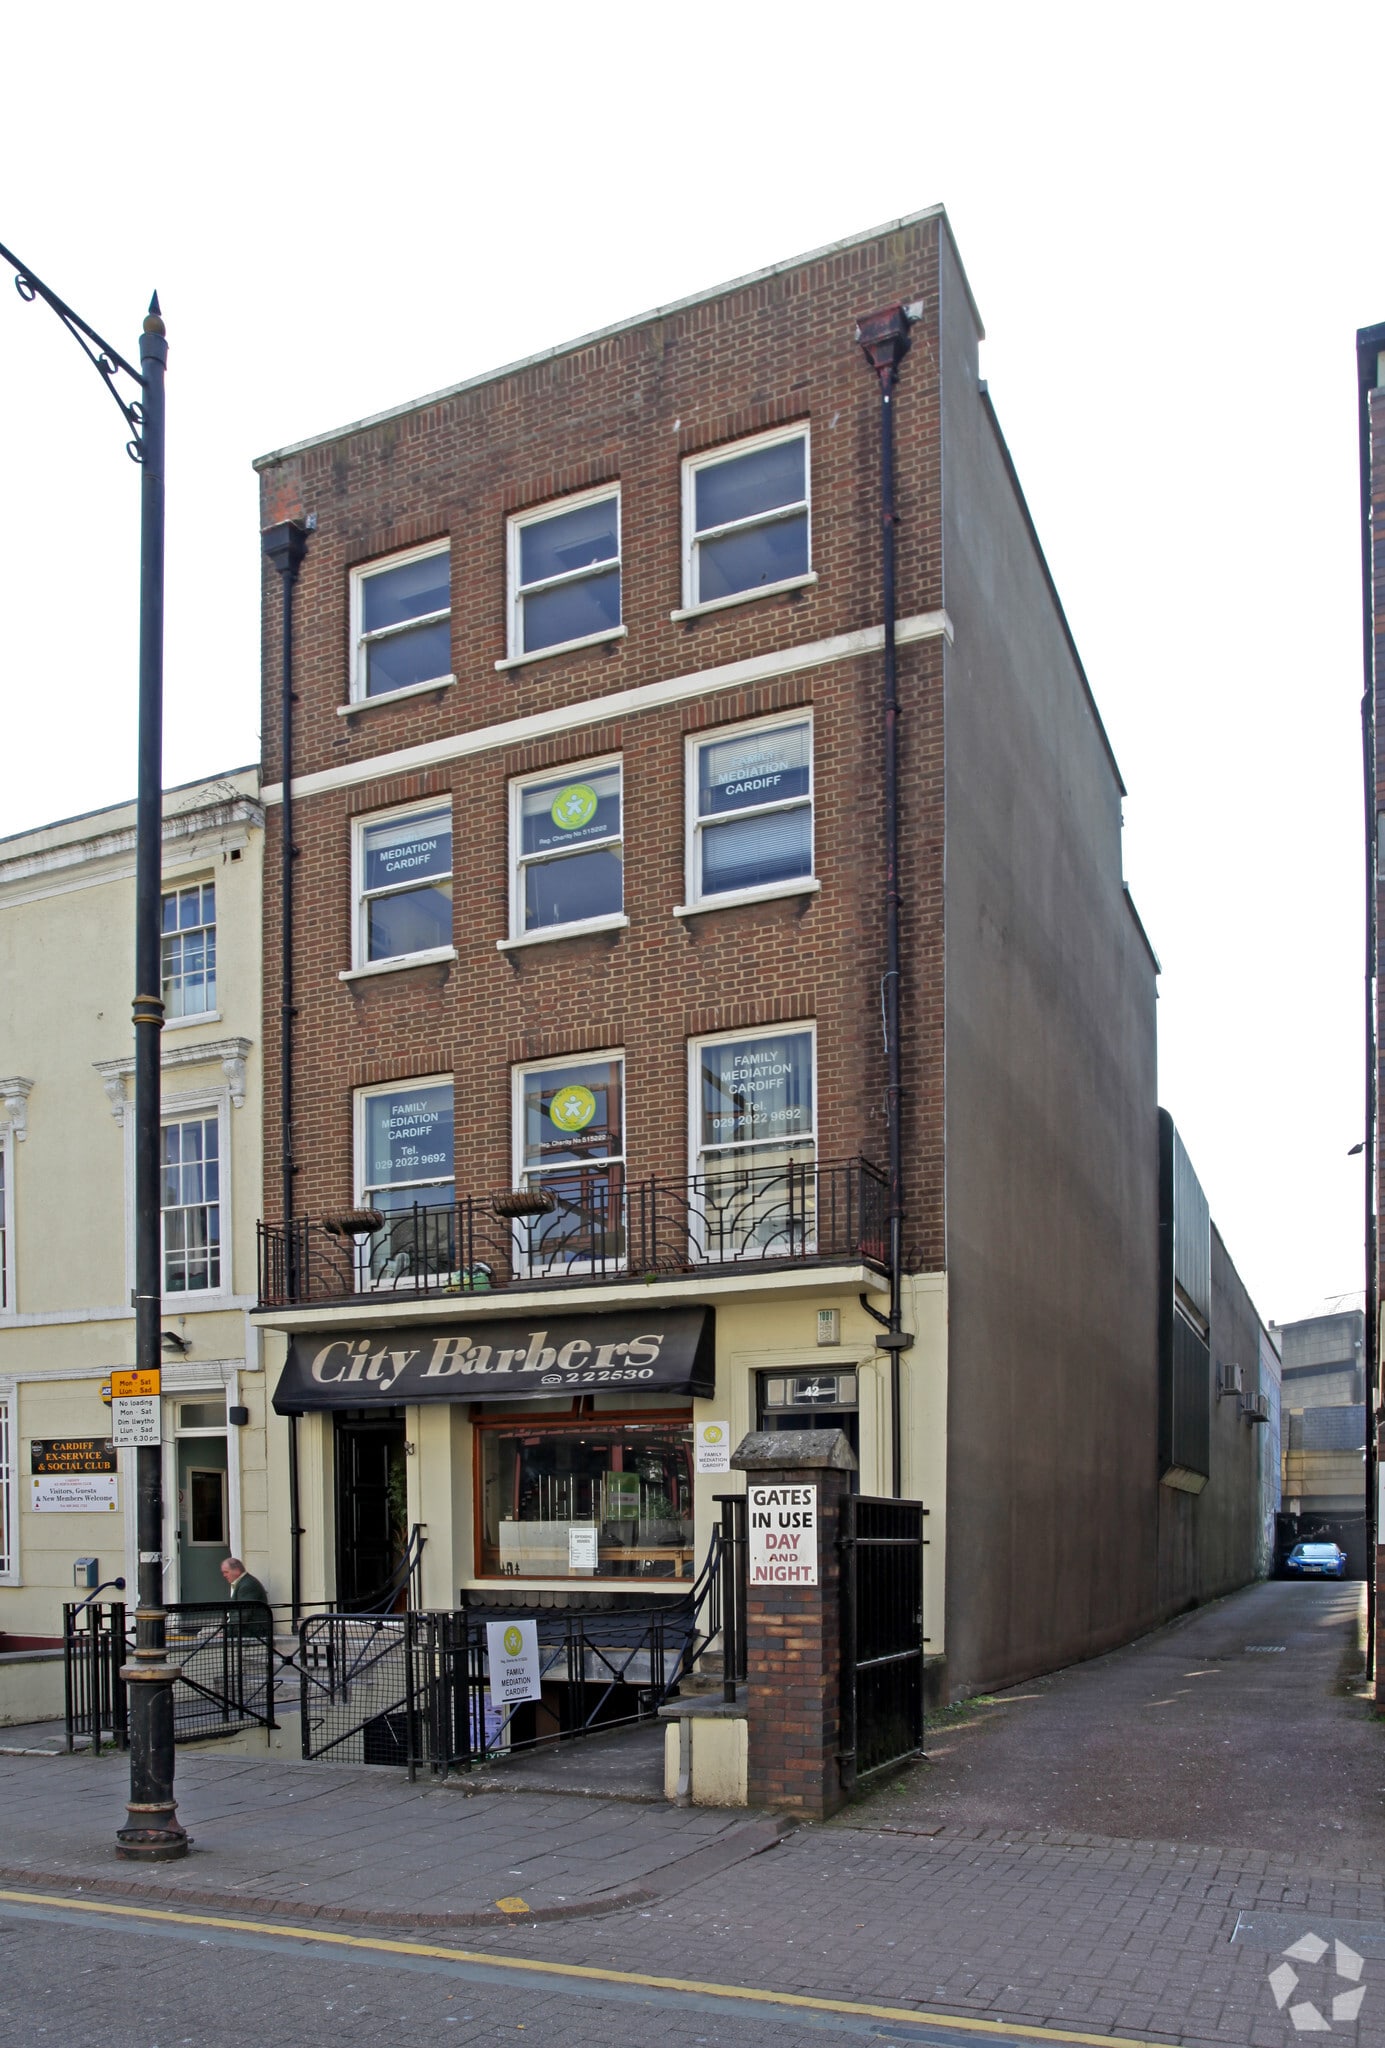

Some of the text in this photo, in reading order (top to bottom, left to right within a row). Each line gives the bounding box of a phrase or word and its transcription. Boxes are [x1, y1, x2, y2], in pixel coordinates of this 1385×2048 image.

[719, 761, 788, 783] MEDIATION
[726, 775, 781, 795] CARDIFF
[380, 840, 437, 861] MEDIATION
[386, 854, 431, 872] CARDIFF
[735, 1051, 778, 1066] FAMILY
[721, 1063, 792, 1081] MEDIATION
[729, 1078, 784, 1094] CARDIFF
[392, 1101, 427, 1115] FAMILY
[746, 1101, 766, 1112] Tel.
[382, 1112, 438, 1128] MEDIATION
[713, 1109, 801, 1128] 029 2022 9692
[388, 1126, 432, 1140] CARDIFF
[401, 1146, 419, 1155] Tel.
[376, 1153, 446, 1170] 029 2022 9692
[312, 1339, 420, 1391] City
[566, 1369, 654, 1383] 222530
[804, 1386, 819, 1396] 42
[52, 1442, 94, 1451] CARDIFF
[46, 1452, 102, 1460] EX-SERVICE
[48, 1462, 83, 1470] SOCIAL
[754, 1489, 811, 1506] GATES
[752, 1512, 812, 1528] IN USE
[766, 1534, 801, 1549] DAY
[769, 1554, 798, 1562] AND
[756, 1566, 812, 1581] NIGHT
[506, 1668, 524, 1676] FAMILY
[502, 1677, 531, 1686] MEDIATION
[505, 1687, 528, 1696] CARDIFF
